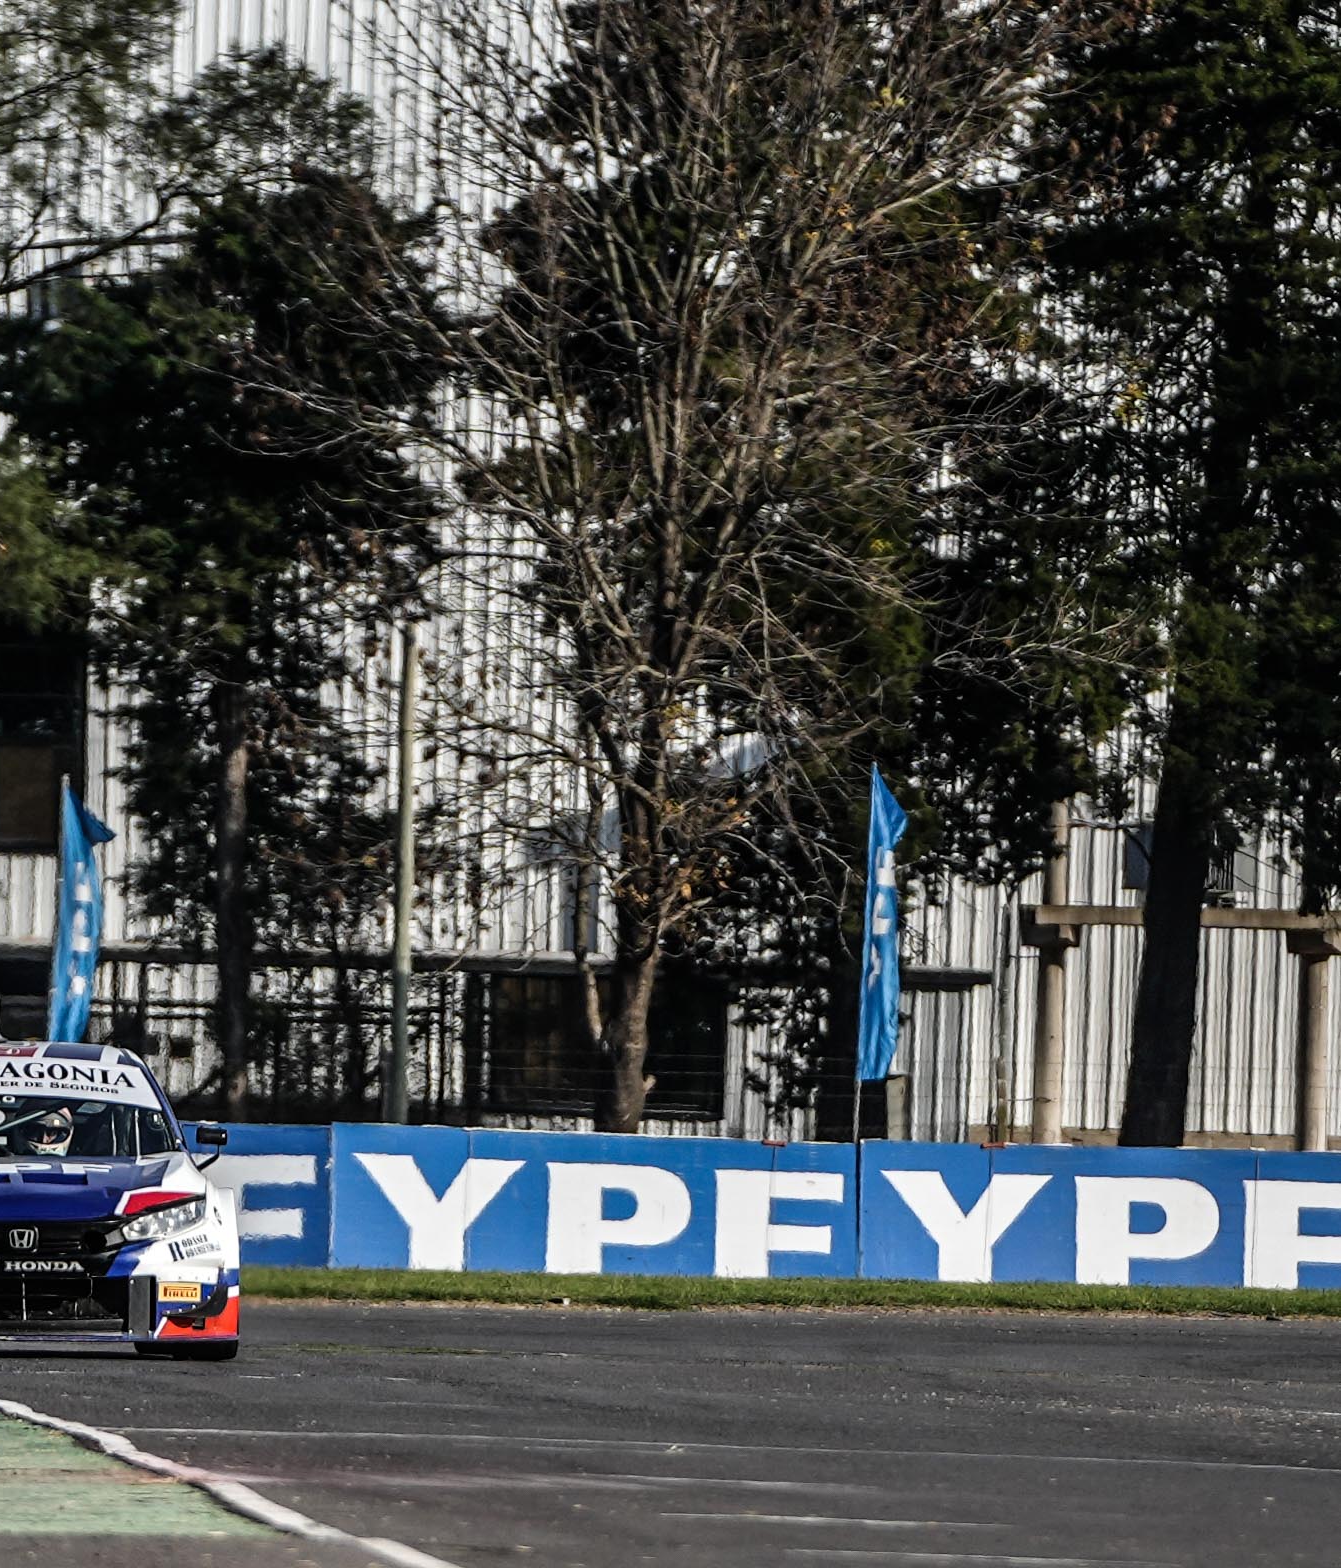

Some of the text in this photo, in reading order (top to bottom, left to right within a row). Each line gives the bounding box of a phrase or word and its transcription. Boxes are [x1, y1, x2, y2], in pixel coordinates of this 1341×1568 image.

[49, 1082, 120, 1094] SEGUROS
[352, 1152, 844, 1278] YPF
[879, 1169, 1341, 1289] YPF
[3, 1261, 85, 1272] HONDA
[163, 1286, 198, 1297] PIRELLI
